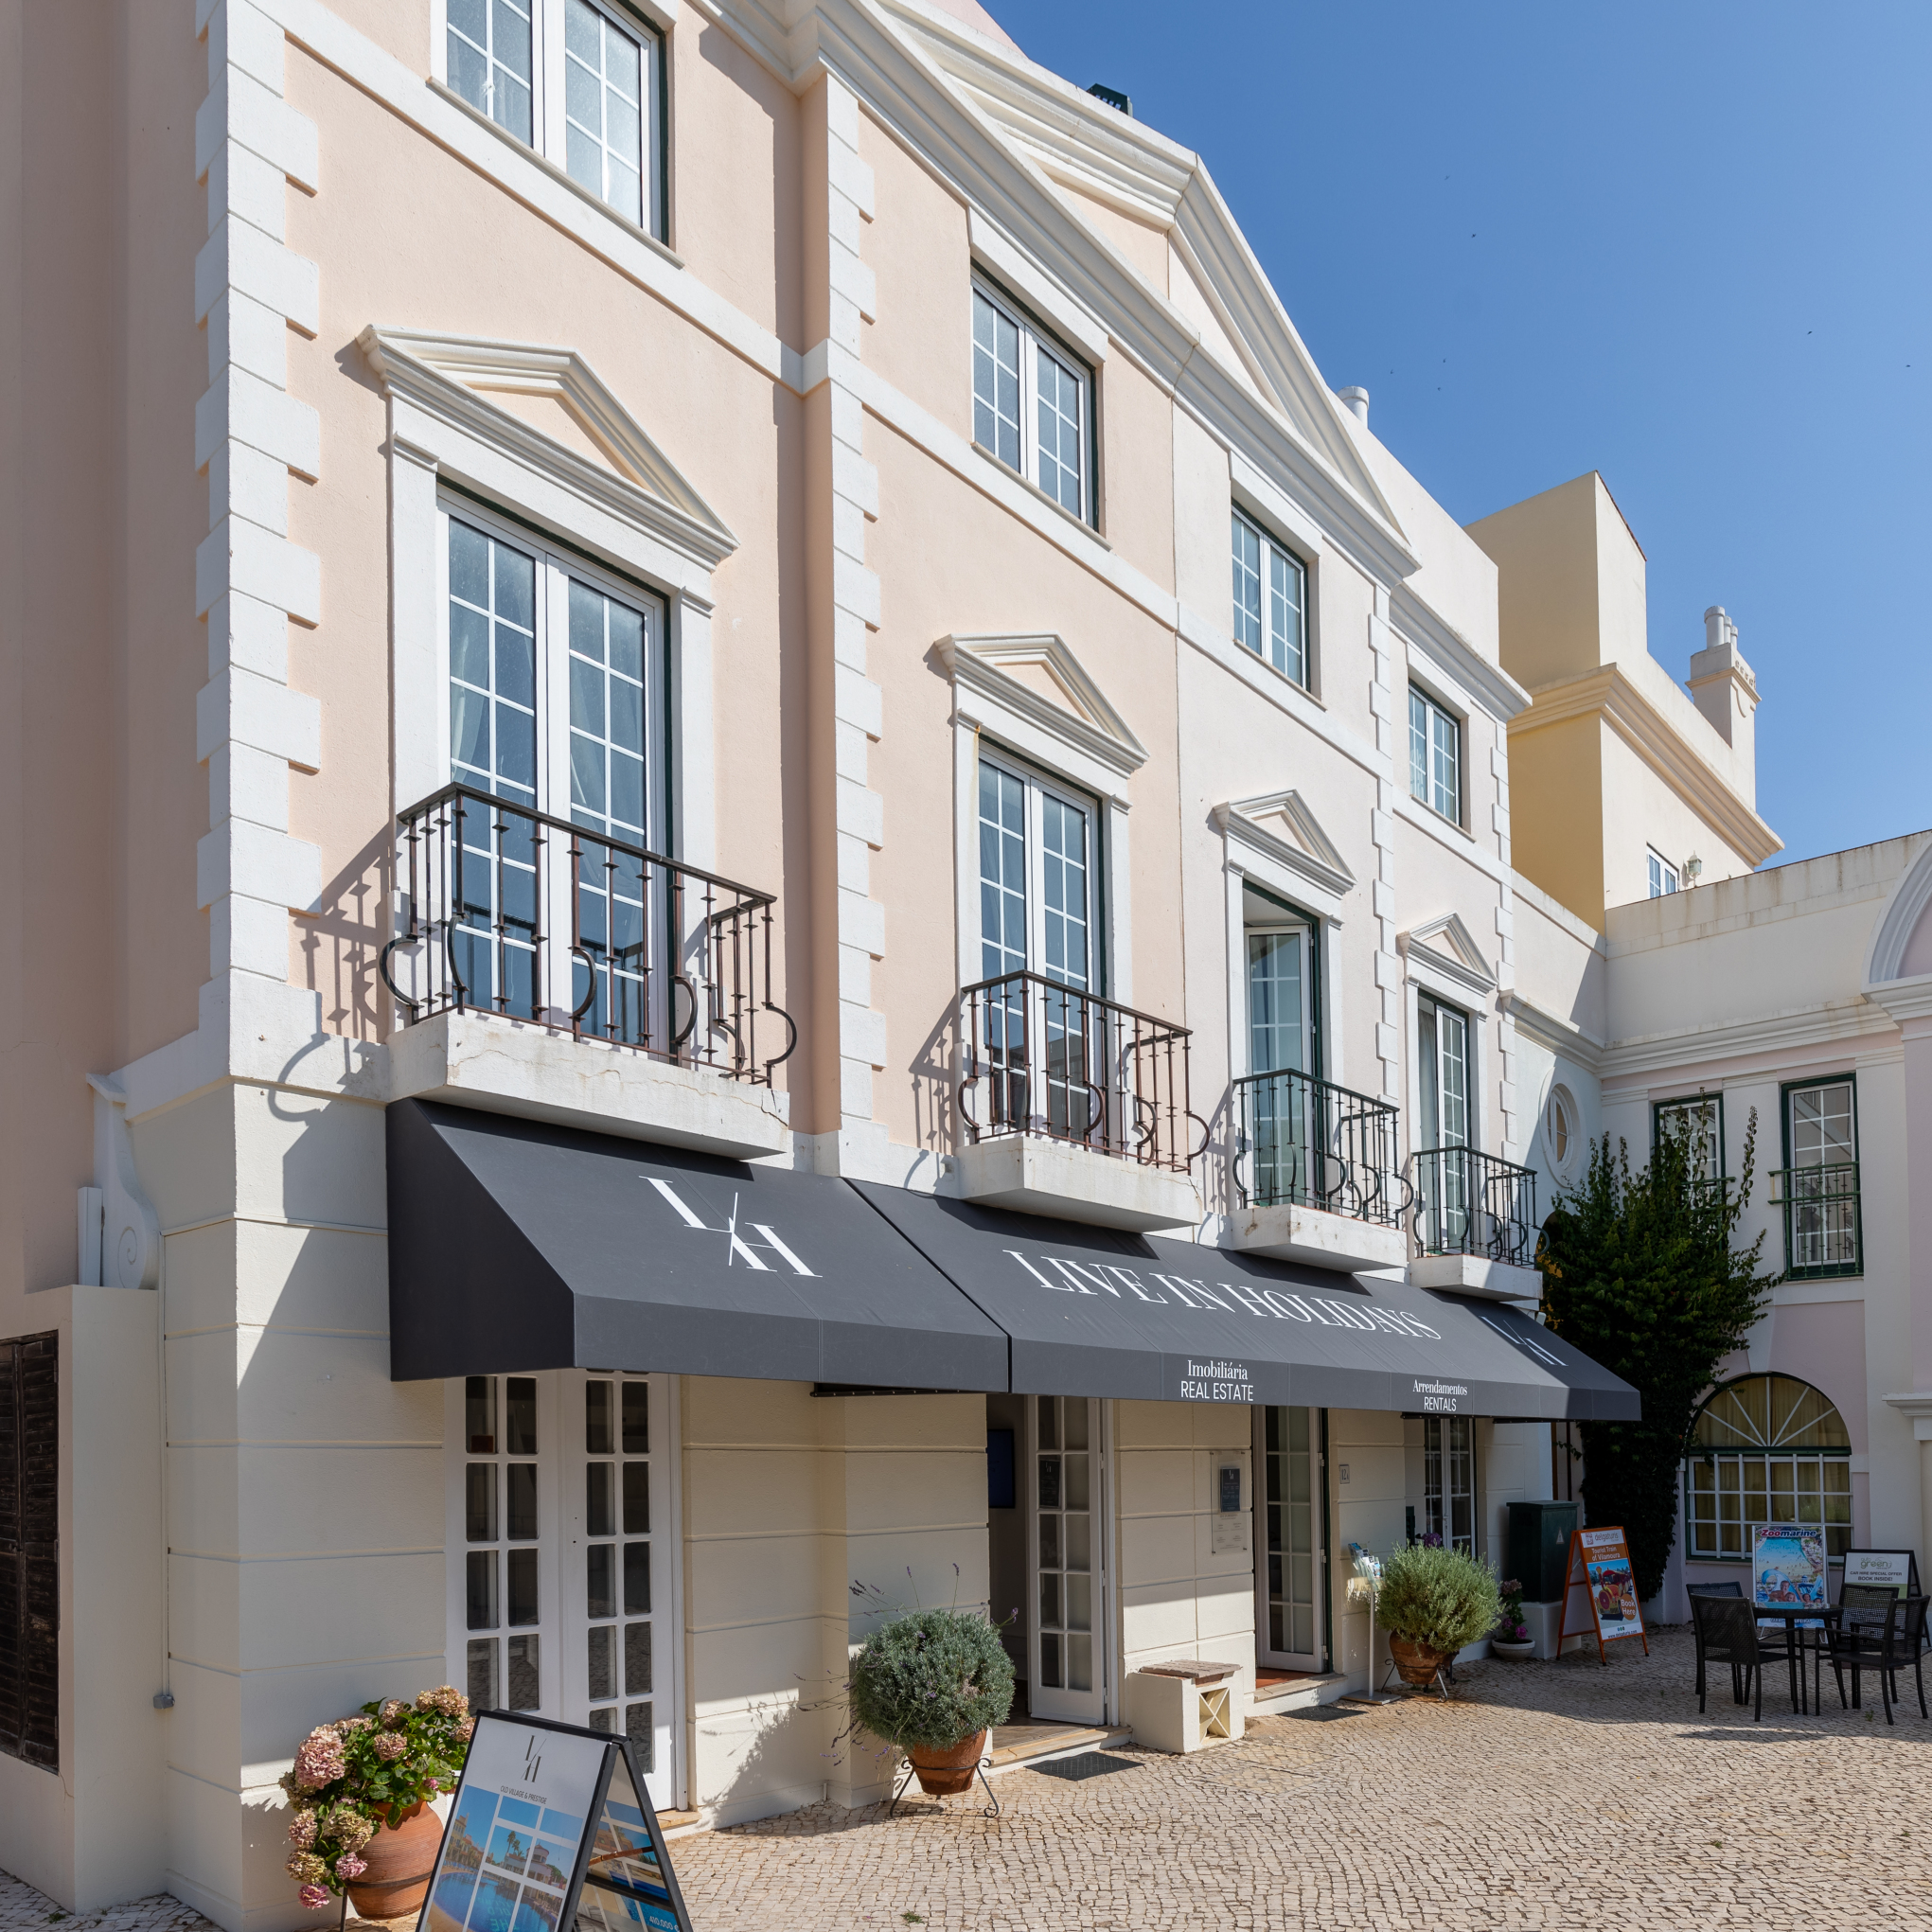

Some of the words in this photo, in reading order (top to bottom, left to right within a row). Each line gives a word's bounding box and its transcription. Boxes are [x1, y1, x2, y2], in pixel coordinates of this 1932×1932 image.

[1002, 1250, 1169, 1304] LIVE
[1148, 1272, 1235, 1313] IN
[1217, 1283, 1442, 1340] HOLIDAYS
[1187, 1359, 1249, 1380] Imobiliária
[1180, 1380, 1210, 1399] REAL
[1213, 1382, 1254, 1401] ESTATE
[1412, 1378, 1468, 1395] Arrendamentos
[1424, 1396, 1457, 1411] RENTALS
[1761, 1528, 1817, 1537] Zoomarine
[1591, 1546, 1606, 1554] Tourist
[1860, 1561, 1888, 1569] green
[1621, 1599, 1636, 1607] Book
[1622, 1607, 1636, 1616] Here
[500, 1785, 509, 1794] OLD
[508, 1787, 525, 1799] VILLAGE
[527, 1793, 548, 1805] PRESTIGE
